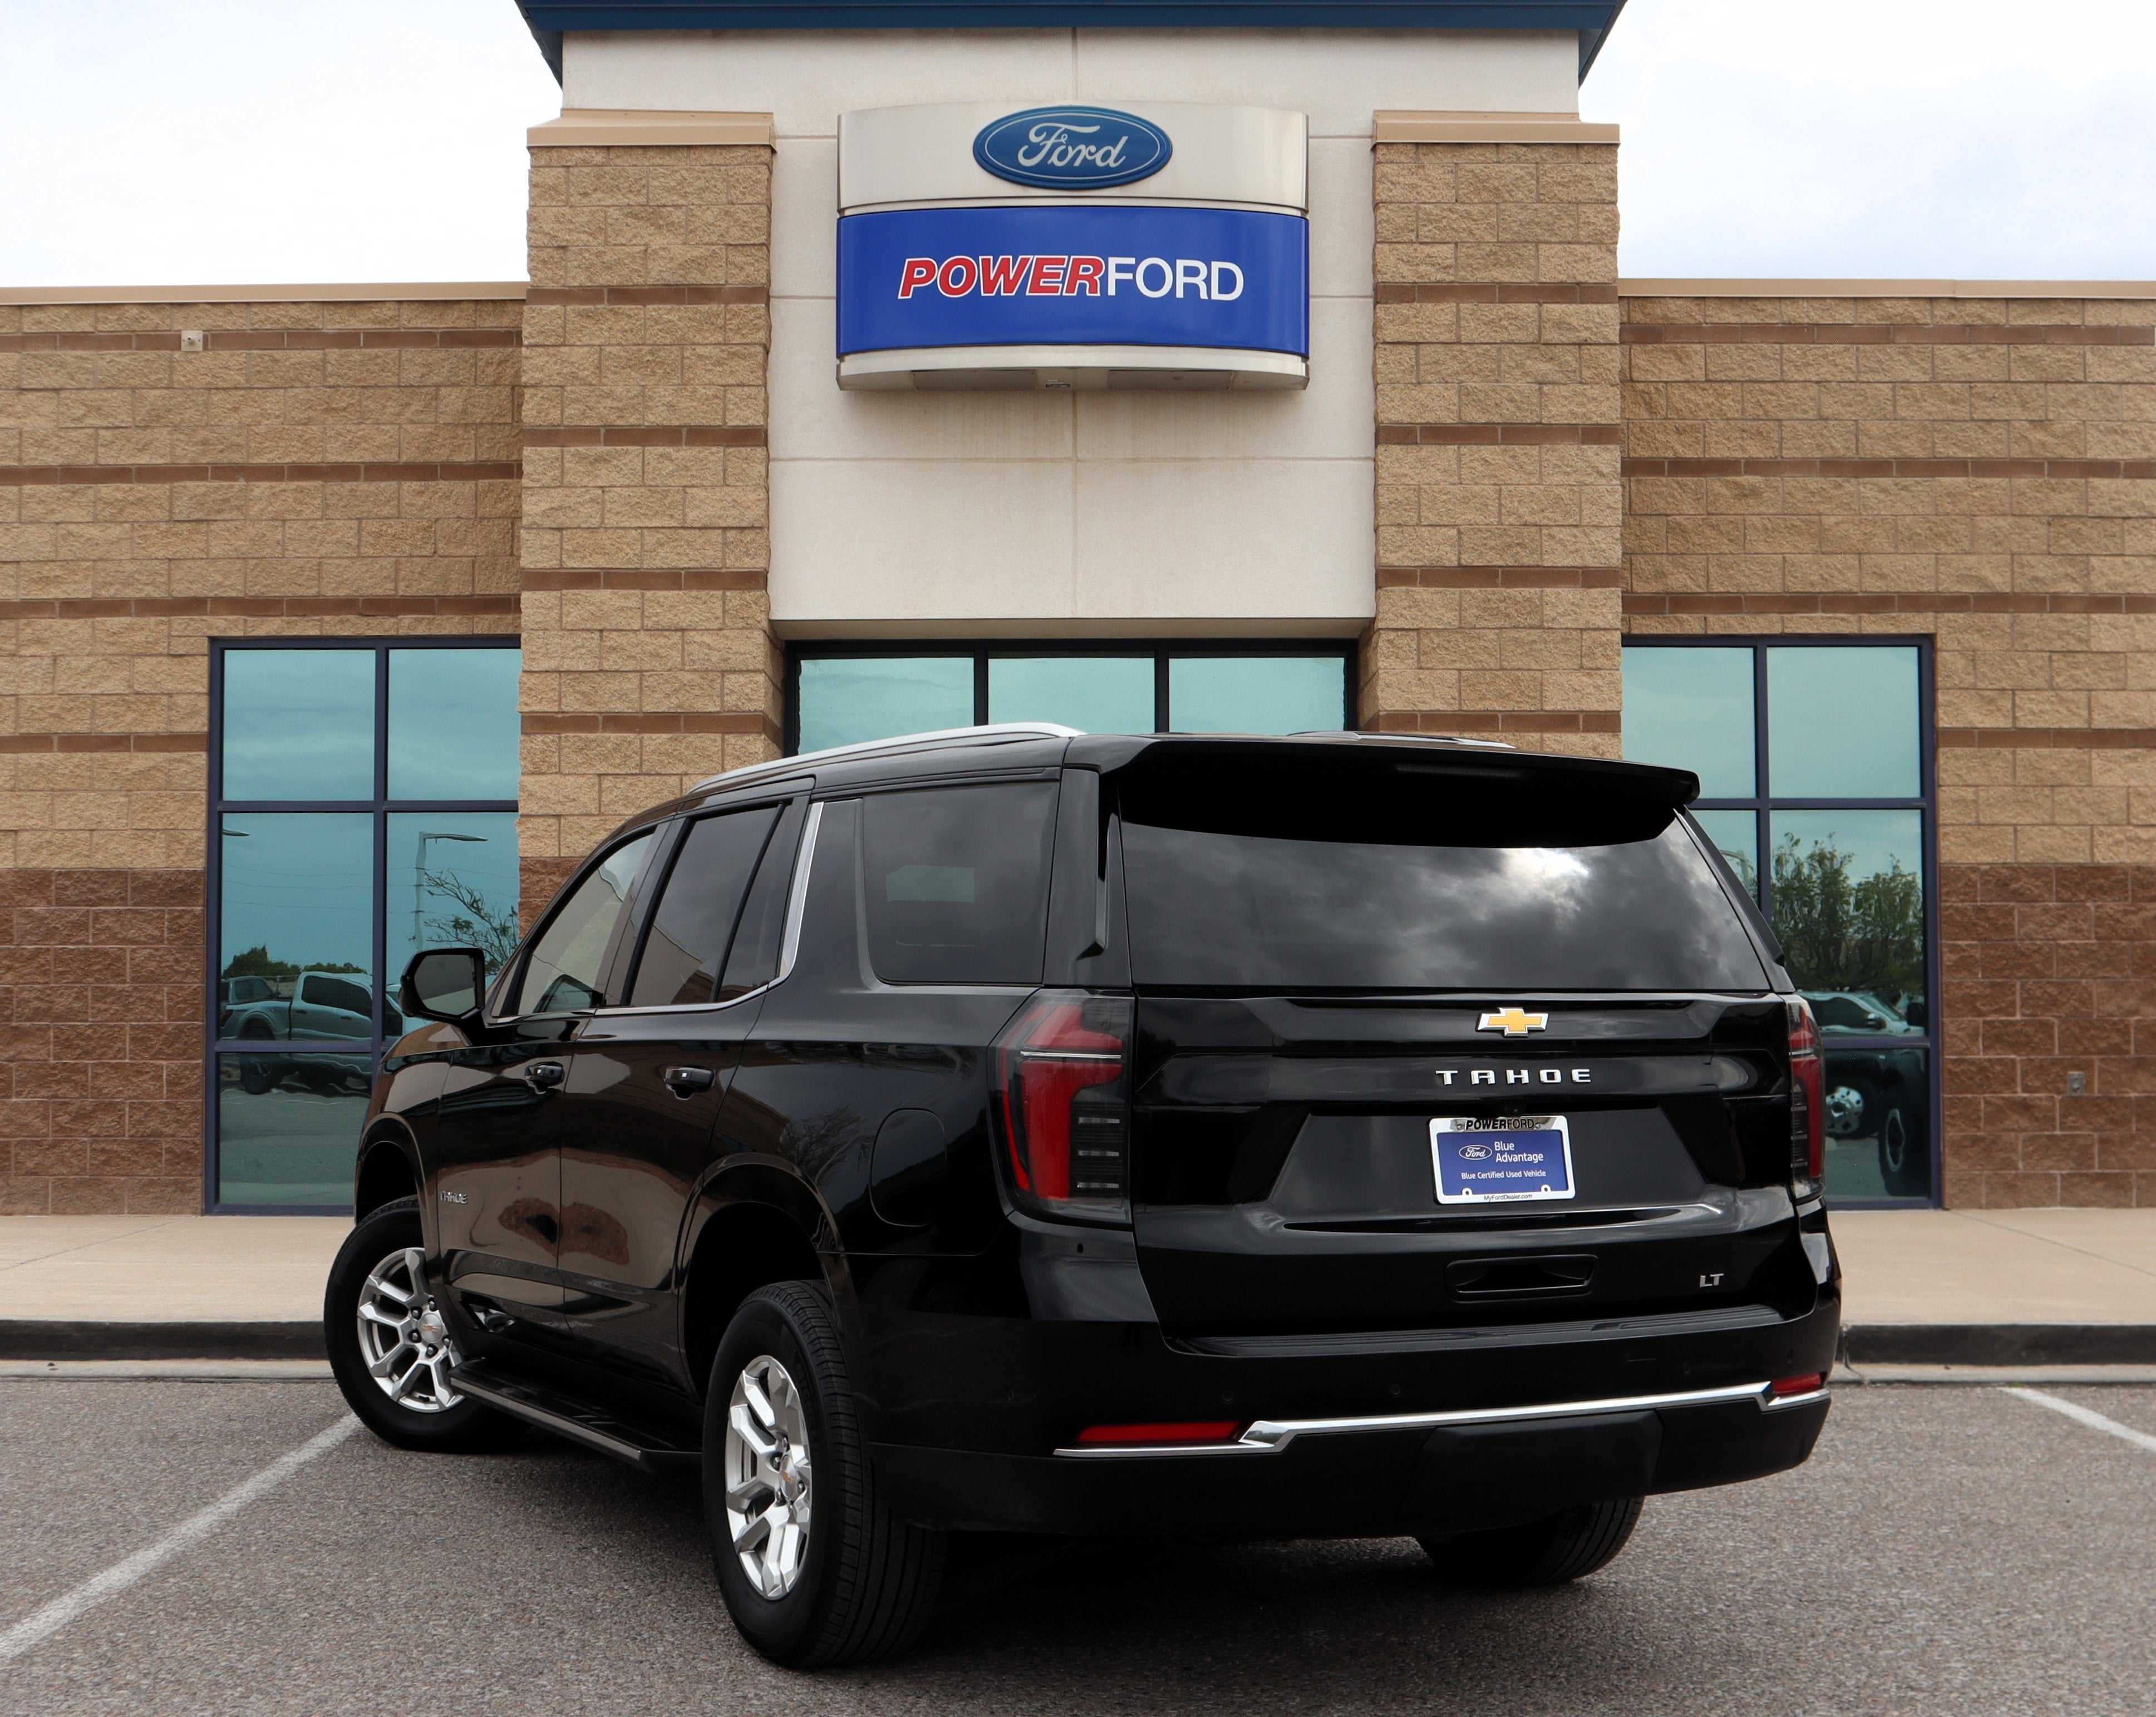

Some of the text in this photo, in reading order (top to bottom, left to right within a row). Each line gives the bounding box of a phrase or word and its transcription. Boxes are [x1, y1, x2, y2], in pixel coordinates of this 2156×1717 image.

[1017, 122, 1128, 168] Ford
[897, 255, 1244, 301] POWERFORD
[1435, 1068, 1591, 1086] TAHOE
[1465, 1118, 1534, 1130] POWERFORD
[1465, 1147, 1486, 1157] Ford
[1494, 1141, 1514, 1151] Blue
[1495, 1152, 1544, 1163] Advantage
[1477, 1171, 1504, 1179] Certified
[1699, 1273, 1724, 1287] LT
